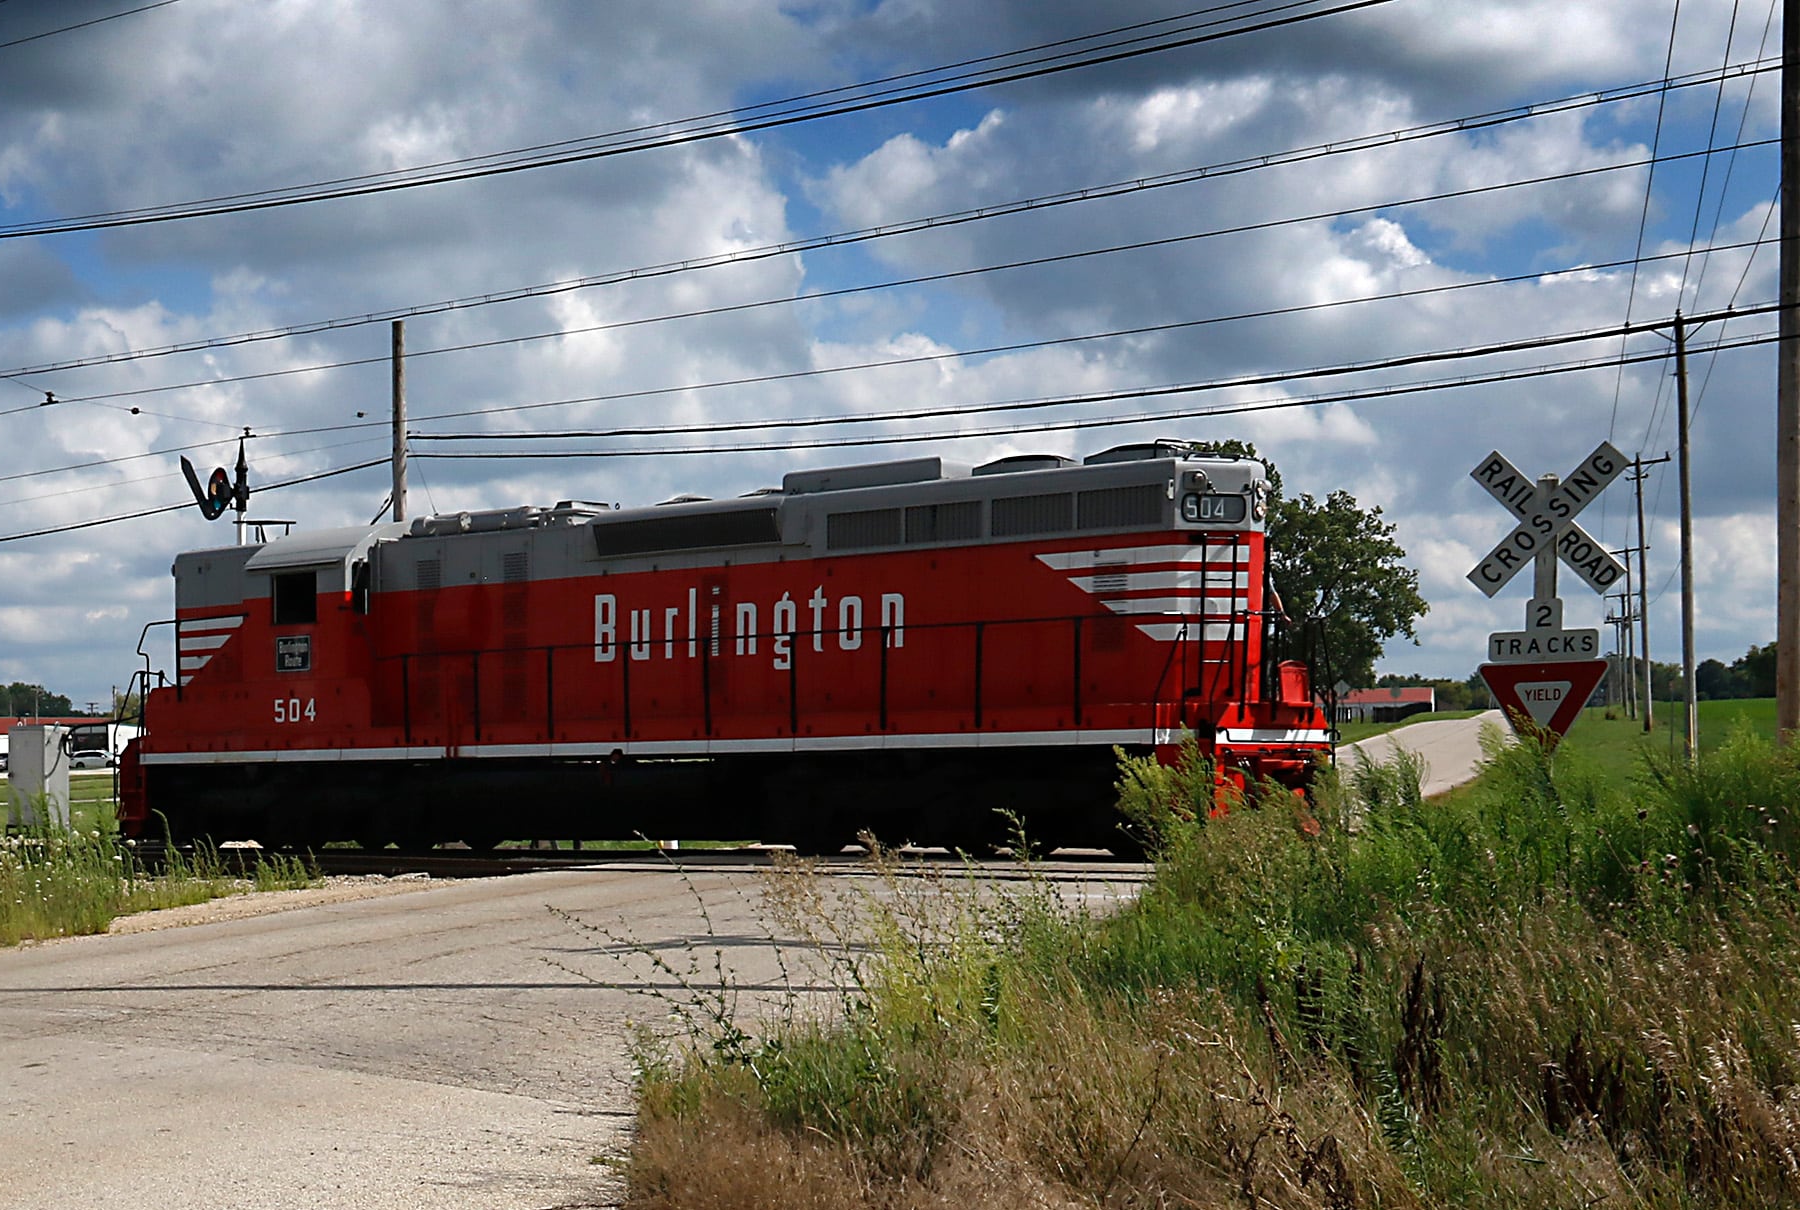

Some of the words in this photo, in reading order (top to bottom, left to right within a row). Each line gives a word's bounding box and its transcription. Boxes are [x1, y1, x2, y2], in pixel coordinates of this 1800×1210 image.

[1478, 458, 1535, 515] RAIL
[1187, 497, 1225, 519] 504
[1480, 455, 1614, 584] CROSSING
[1558, 530, 1618, 588] ROAD
[594, 584, 905, 671] Burlington
[1536, 605, 1552, 628] 2
[1494, 635, 1593, 656] TRACKS
[1523, 688, 1562, 702] YIELD
[273, 697, 318, 723] 504
